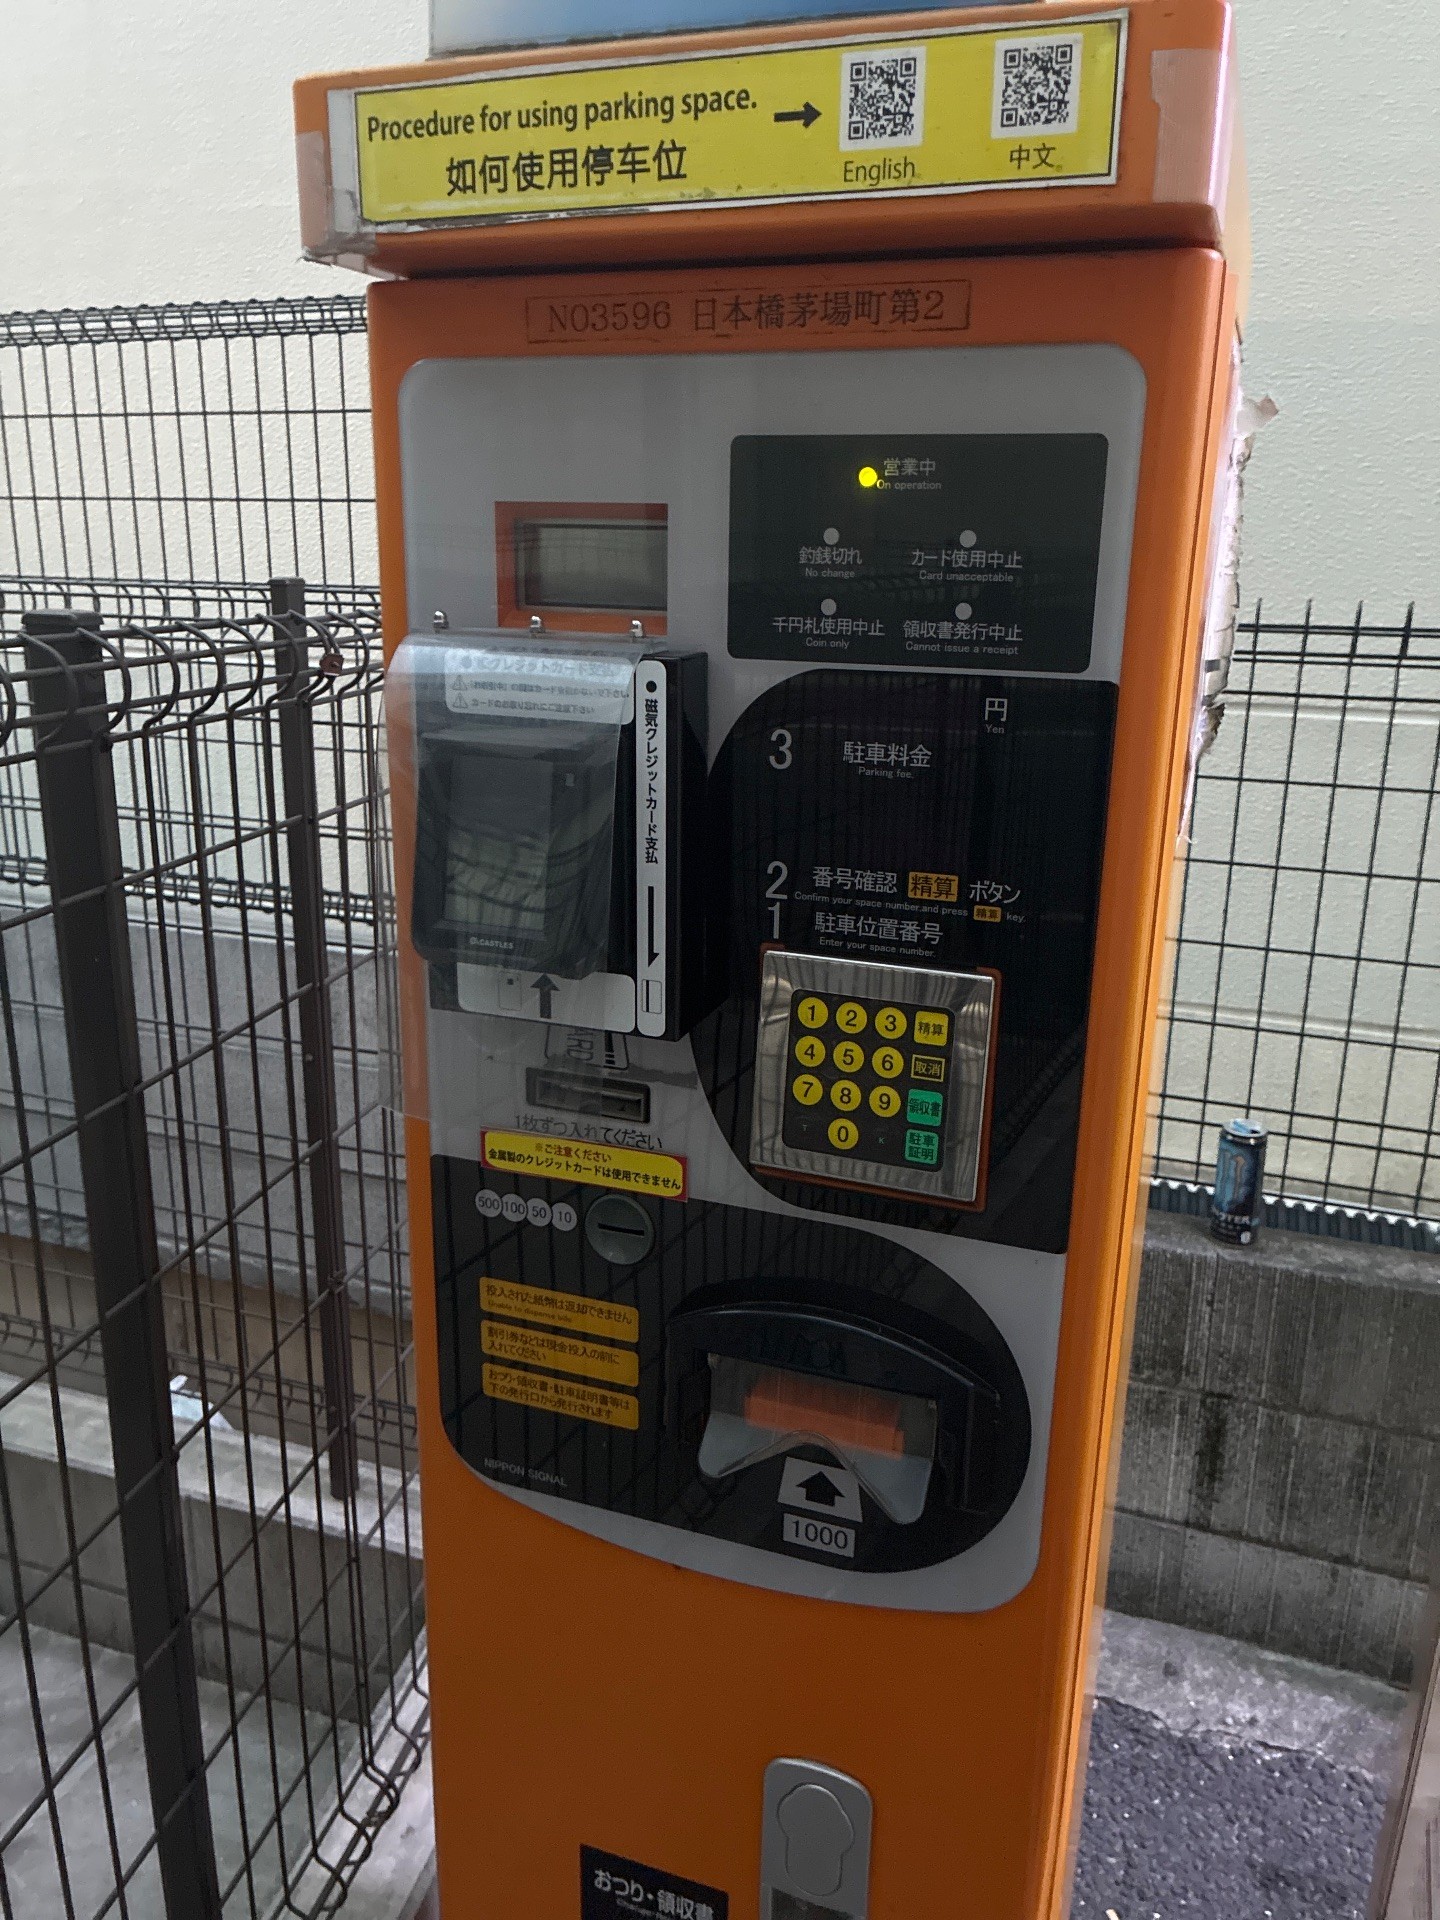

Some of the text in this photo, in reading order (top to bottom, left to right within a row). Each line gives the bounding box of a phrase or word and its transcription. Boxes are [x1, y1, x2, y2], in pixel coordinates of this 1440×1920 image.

[368, 88, 757, 142] Procedure for using parking space.
[1009, 142, 1056, 171] 中文
[446, 139, 687, 197] 如何使用停车位
[843, 156, 917, 187] English
[693, 289, 945, 331] 日本橋茅場町第2
[883, 458, 936, 477] 営業中
[876, 479, 942, 491] On operation
[798, 546, 863, 565] 釣銭切れ
[911, 548, 1023, 570] カード使用中止
[805, 568, 855, 580] No change
[919, 570, 1014, 583] Card unacceptable
[772, 616, 886, 637] 千円札使用中止
[902, 620, 1023, 642] 領収書発行中止
[805, 638, 850, 650] Coin only
[905, 641, 940, 653] Cannot
[944, 643, 970, 654] issue
[982, 645, 1019, 657] receipt
[985, 697, 1008, 722] 円
[985, 723, 1005, 735] Yen
[769, 728, 793, 770] 3
[843, 740, 932, 768] 駐車料金
[645, 698, 658, 864] 磁気クレジットカード支払
[858, 766, 894, 779] Parking
[765, 861, 789, 900] 2
[812, 866, 1021, 904] 番号確認 精算 ボタン
[794, 890, 830, 903] Confirm
[832, 895, 853, 906] your
[855, 898, 882, 909] space
[941, 907, 968, 919] press
[767, 902, 781, 939] 1
[814, 911, 943, 945] 駐車位置番号
[480, 938, 514, 949] CASTLES
[819, 937, 844, 948] Enter
[846, 940, 867, 951] your
[869, 943, 896, 955] space
[807, 1005, 815, 1021] 1
[846, 1010, 857, 1027] 2
[885, 1015, 897, 1032] 3
[917, 1021, 944, 1037] 精算
[804, 1044, 815, 1060] 4
[843, 1049, 854, 1066] 5
[882, 1054, 893, 1071] 6
[915, 1061, 941, 1076] 取消
[802, 1081, 814, 1098] 7
[840, 1087, 851, 1105] 8
[879, 1093, 890, 1110] 9
[908, 1098, 941, 1118] 領収書
[515, 1114, 663, 1149] 1枚ずつ入れてください
[837, 1126, 849, 1142] 0
[909, 1132, 935, 1146] 駐車
[908, 1147, 934, 1161] 証明
[488, 1148, 681, 1190] 金属製のクレジットカードは使用できません
[478, 1196, 572, 1224] 500 100 50 10
[485, 1458, 568, 1487] NIPPON SIGNAL
[793, 1520, 847, 1549] 1000
